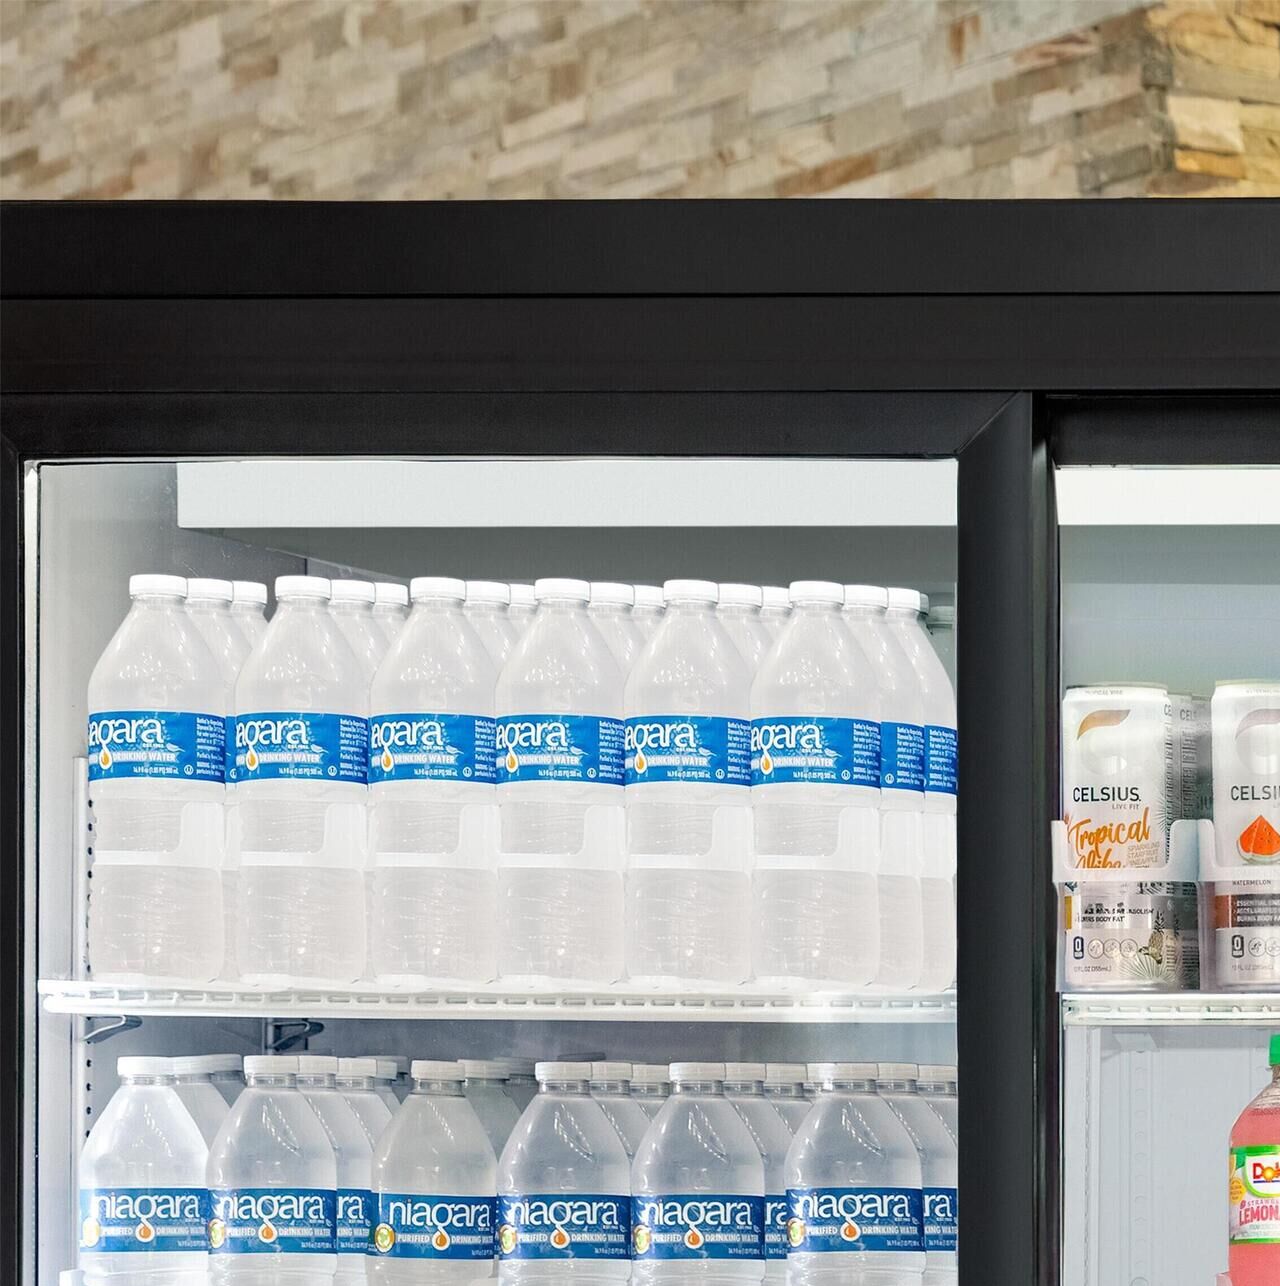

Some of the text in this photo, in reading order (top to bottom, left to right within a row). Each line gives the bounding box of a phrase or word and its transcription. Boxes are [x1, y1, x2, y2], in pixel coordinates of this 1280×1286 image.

[1073, 786, 1141, 802] CELSIUS
[1068, 808, 1151, 857] Tropical
[216, 1193, 324, 1226] niagara
[389, 1199, 491, 1232] niagara
[508, 1200, 619, 1232] niagara
[643, 1199, 753, 1230] niagara
[797, 1192, 911, 1224] niagara
